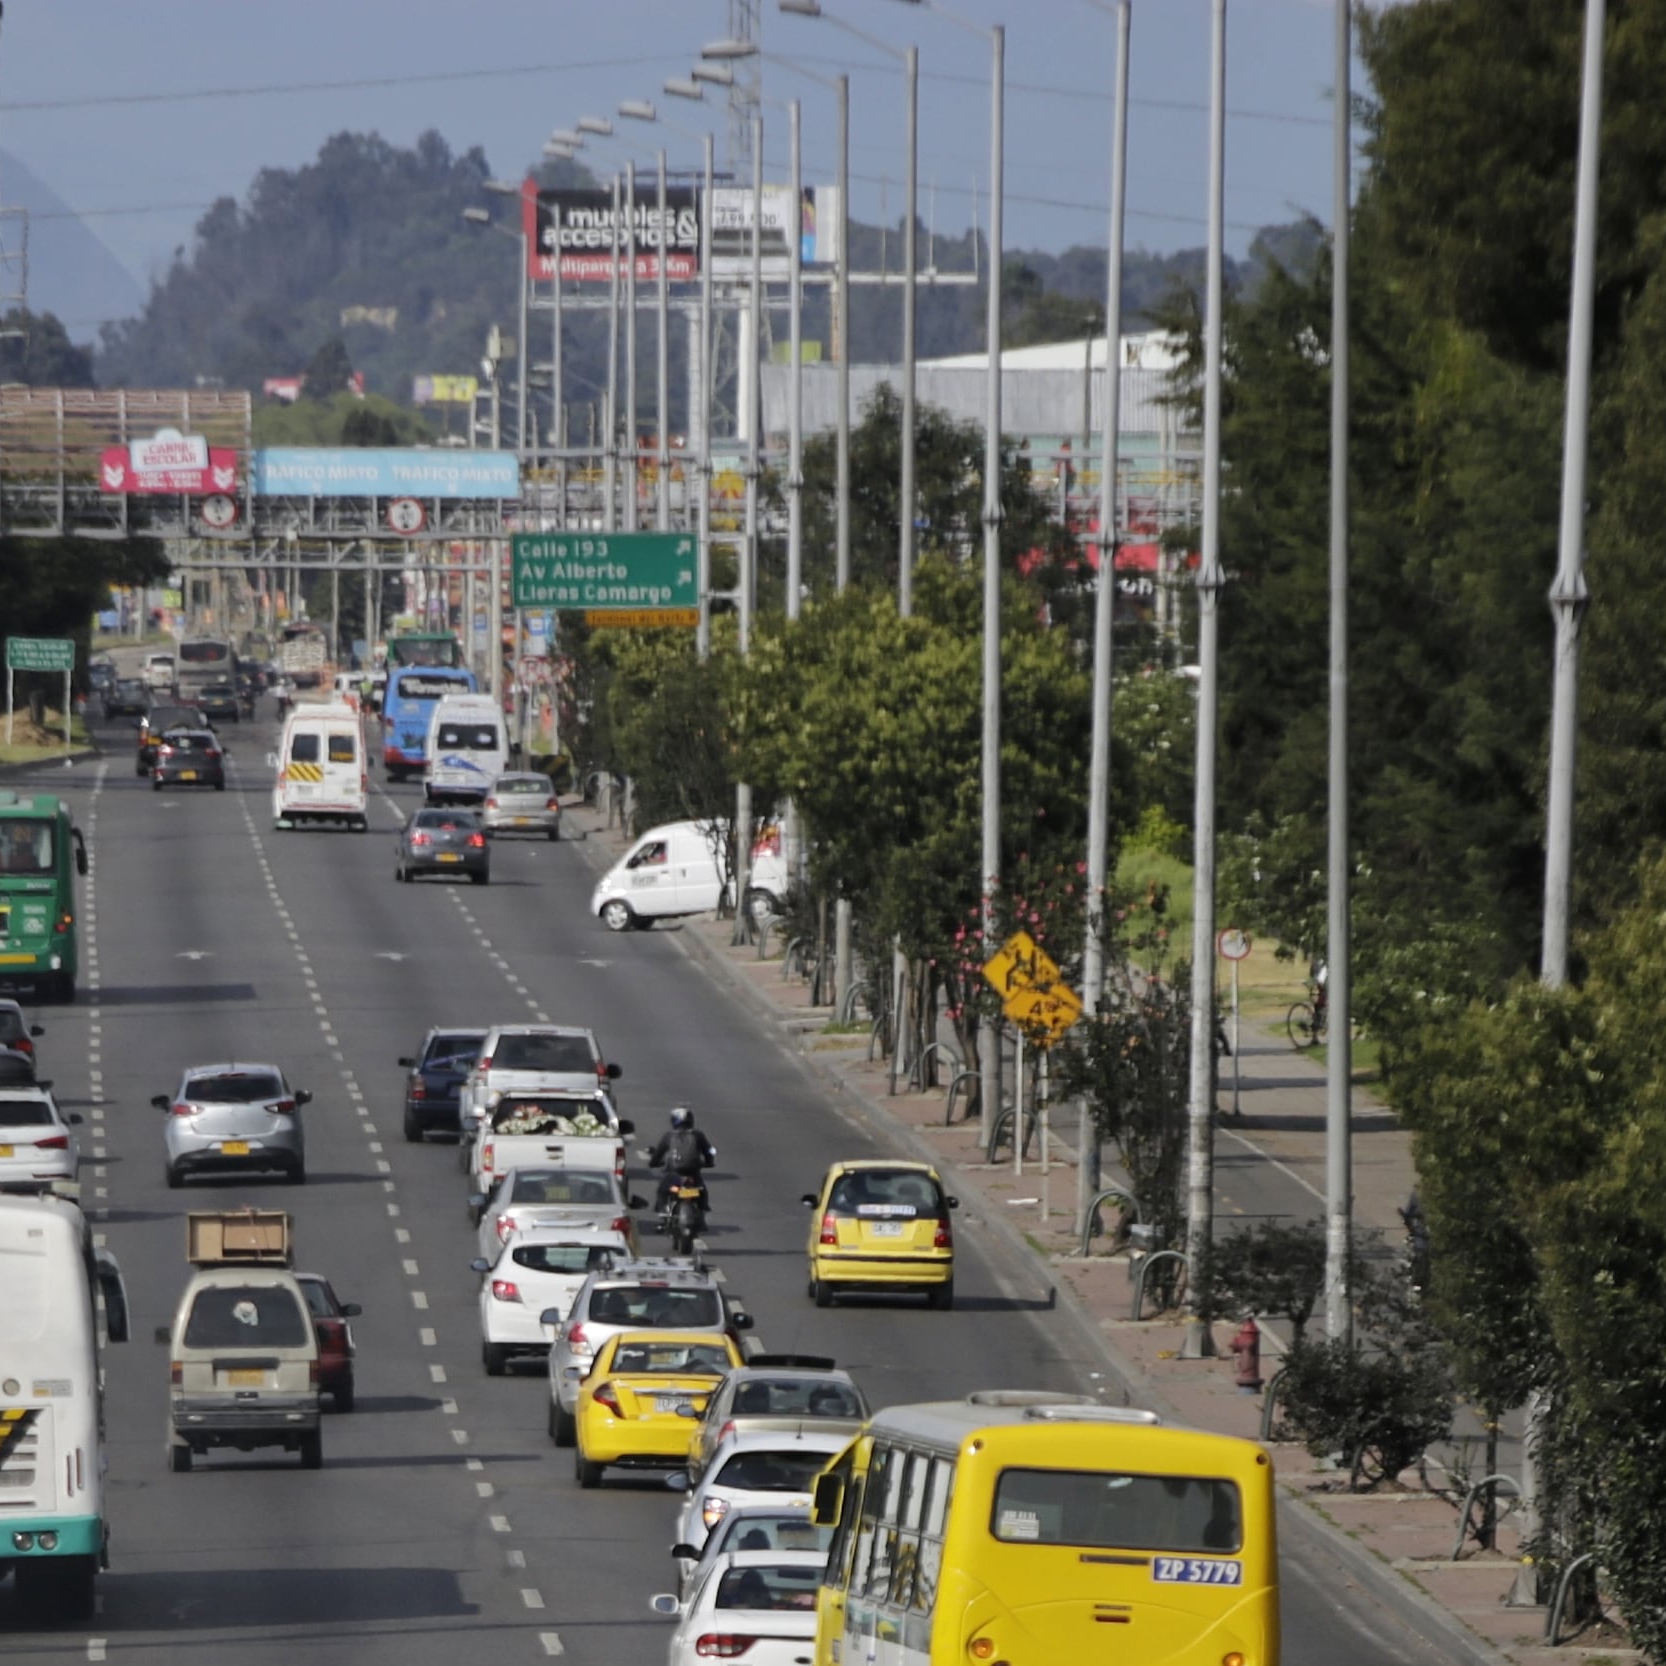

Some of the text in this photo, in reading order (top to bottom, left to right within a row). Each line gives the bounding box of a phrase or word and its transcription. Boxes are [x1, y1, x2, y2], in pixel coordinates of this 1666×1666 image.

[568, 203, 676, 227] muebles
[519, 540, 609, 558] Calle 193
[520, 561, 628, 580] Av Alberto
[519, 584, 673, 605] Lleras Camargo
[1158, 1560, 1239, 1583] ZP 5779
